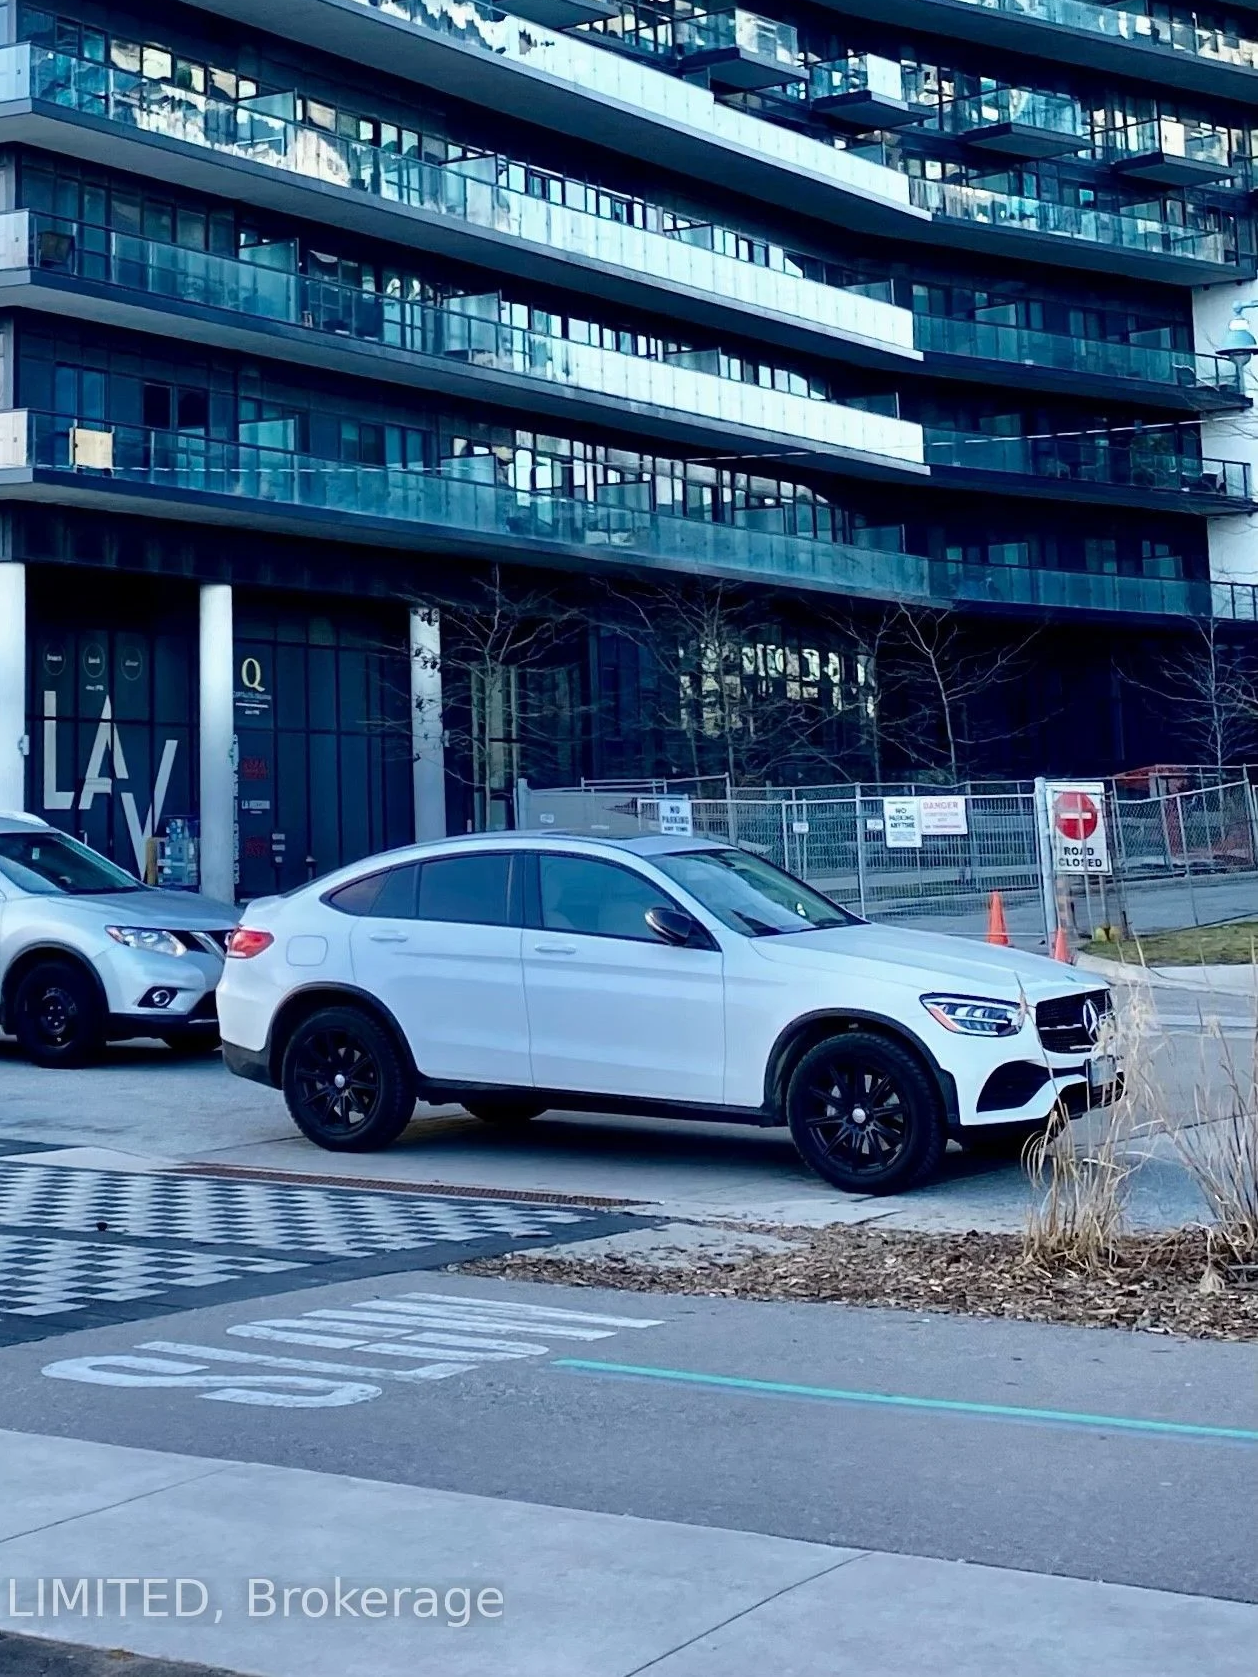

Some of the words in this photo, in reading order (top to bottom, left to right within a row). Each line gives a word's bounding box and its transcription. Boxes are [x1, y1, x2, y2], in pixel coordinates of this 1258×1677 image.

[242, 658, 265, 692] Q
[44, 690, 179, 884] LAV
[669, 805, 681, 814] NO
[1058, 858, 1103, 868] CLOED
